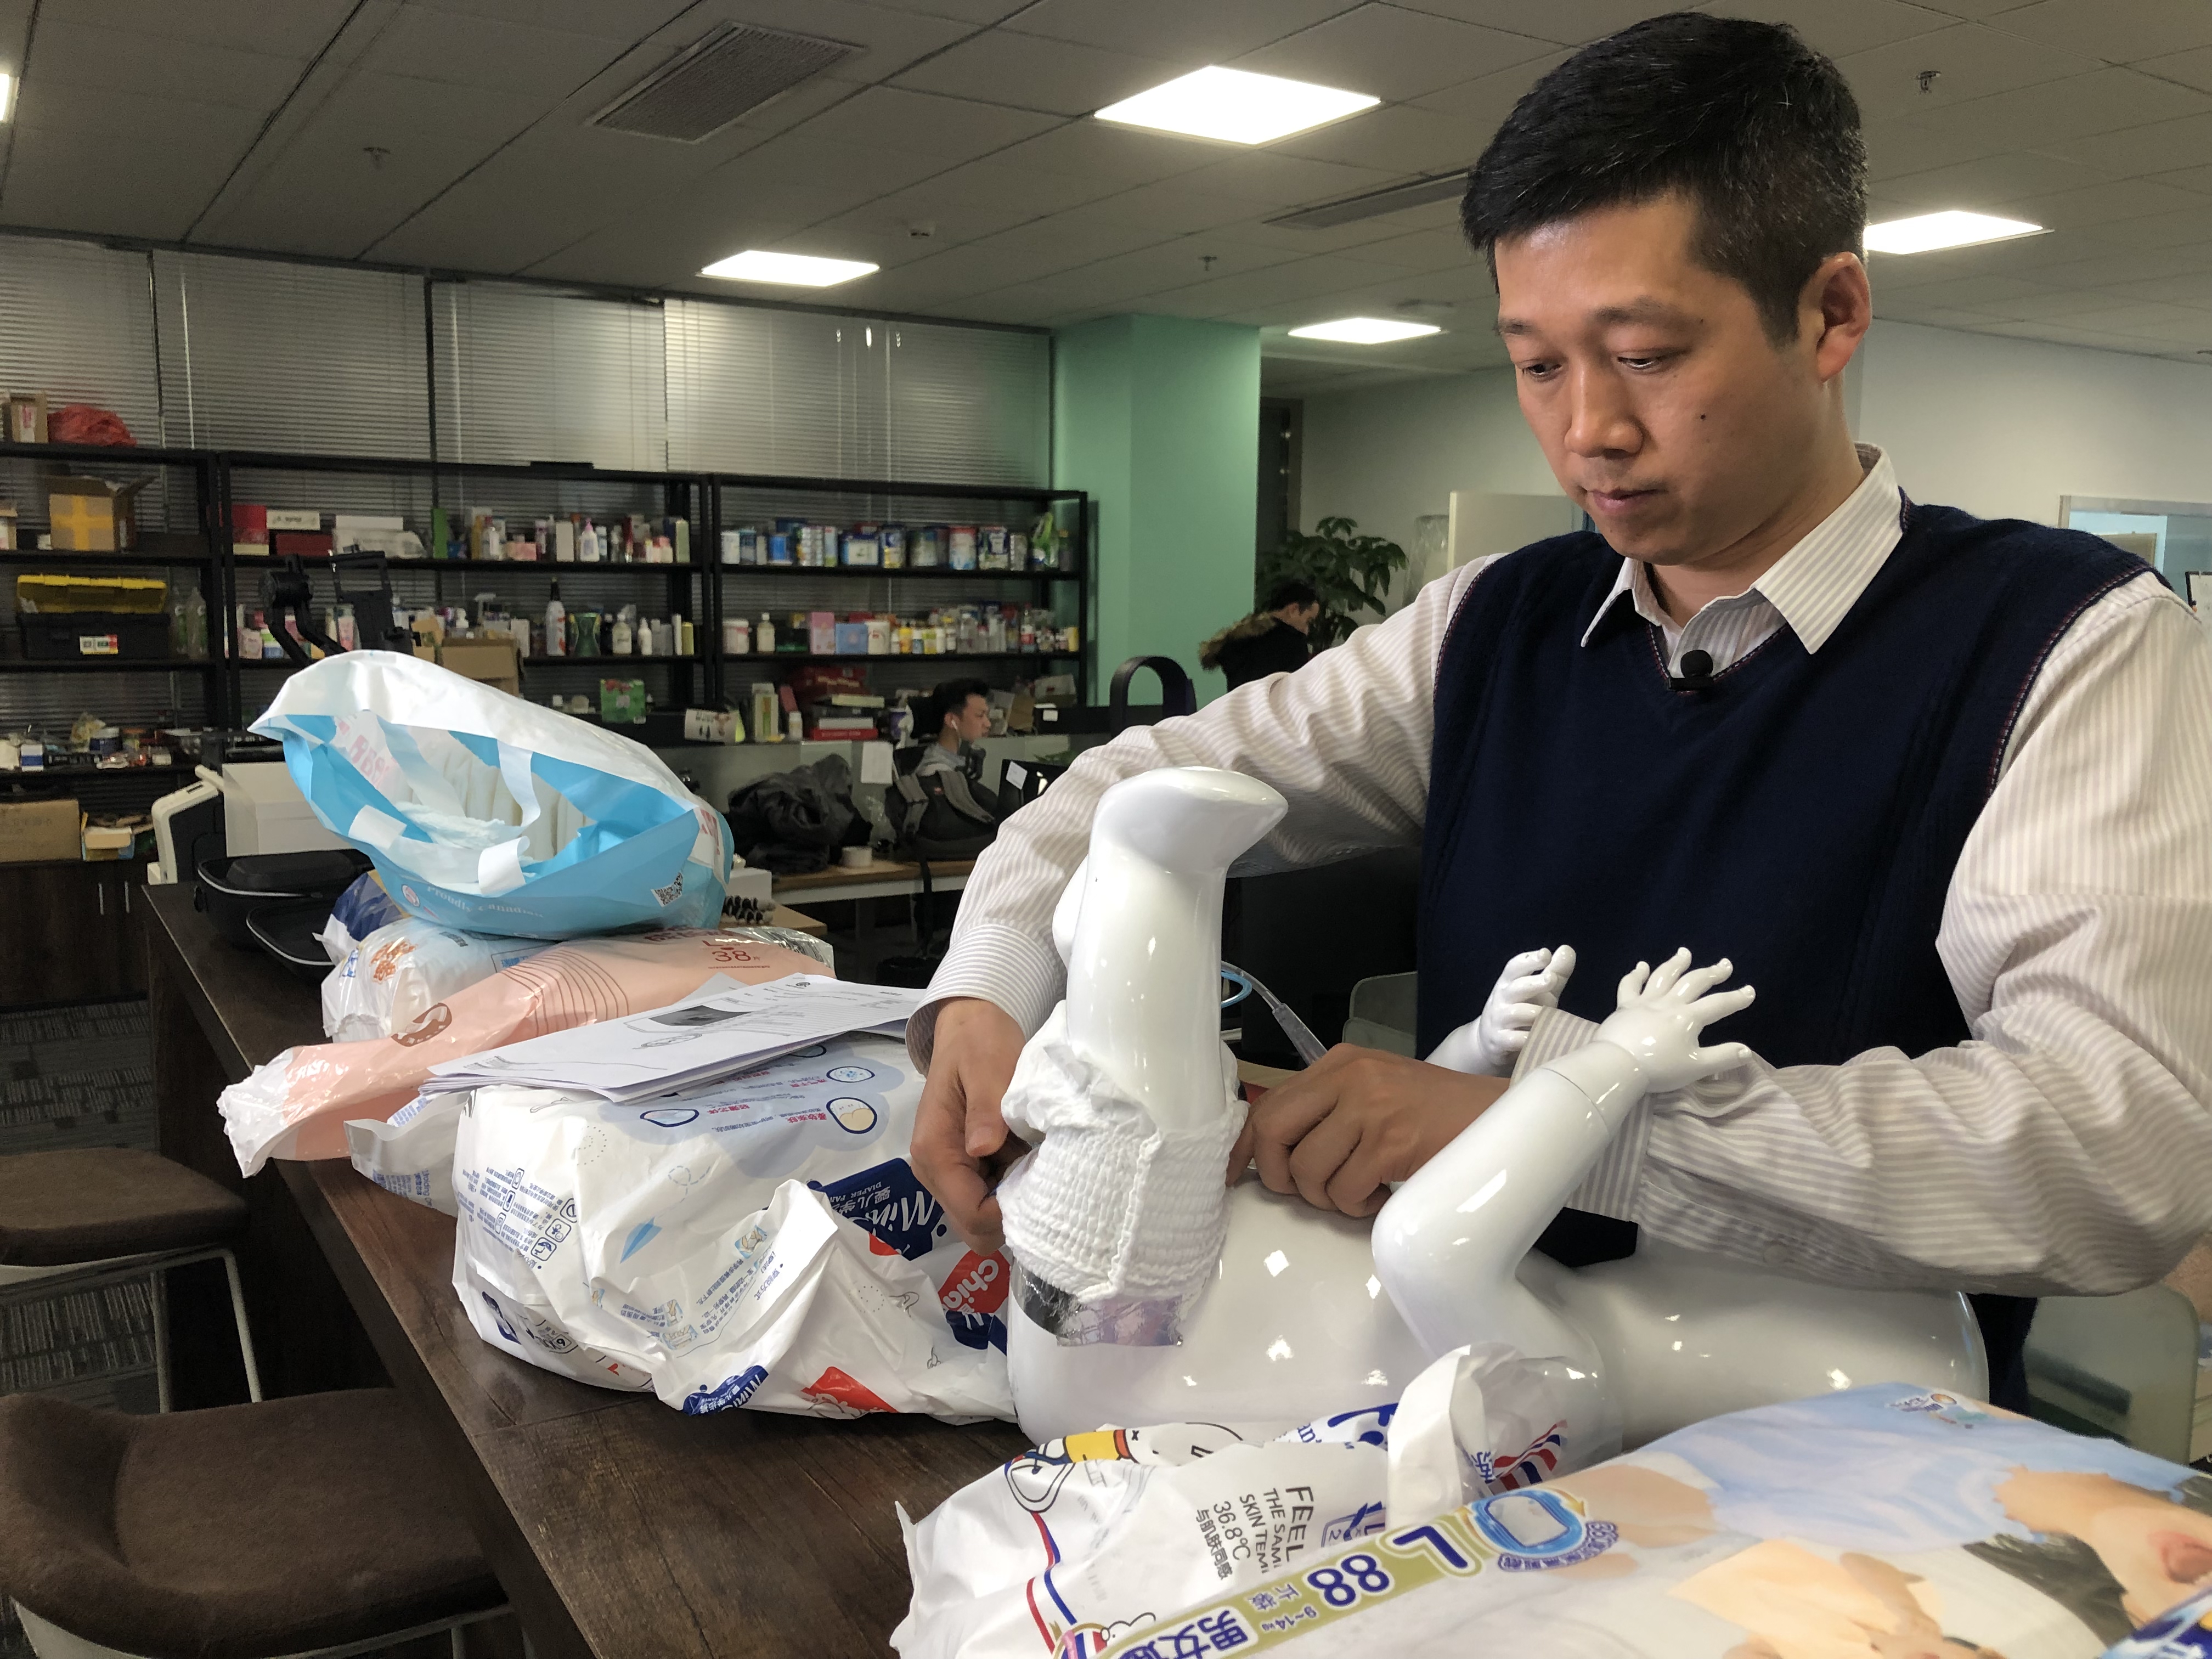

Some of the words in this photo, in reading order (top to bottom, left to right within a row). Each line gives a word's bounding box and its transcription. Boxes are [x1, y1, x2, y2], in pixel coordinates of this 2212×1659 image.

[712, 950, 752, 962] 38
[827, 1194, 847, 1203] PAN
[850, 1181, 882, 1199] DIAPER
[942, 1259, 999, 1309] Chia
[1239, 1493, 1266, 1527] SKIN
[1263, 1487, 1286, 1519] THE
[1285, 1486, 1314, 1562] FEEL
[1195, 1509, 1233, 1581] 与肌肤同感
[1392, 1525, 1469, 1569] L
[1307, 1554, 1390, 1607] 88
